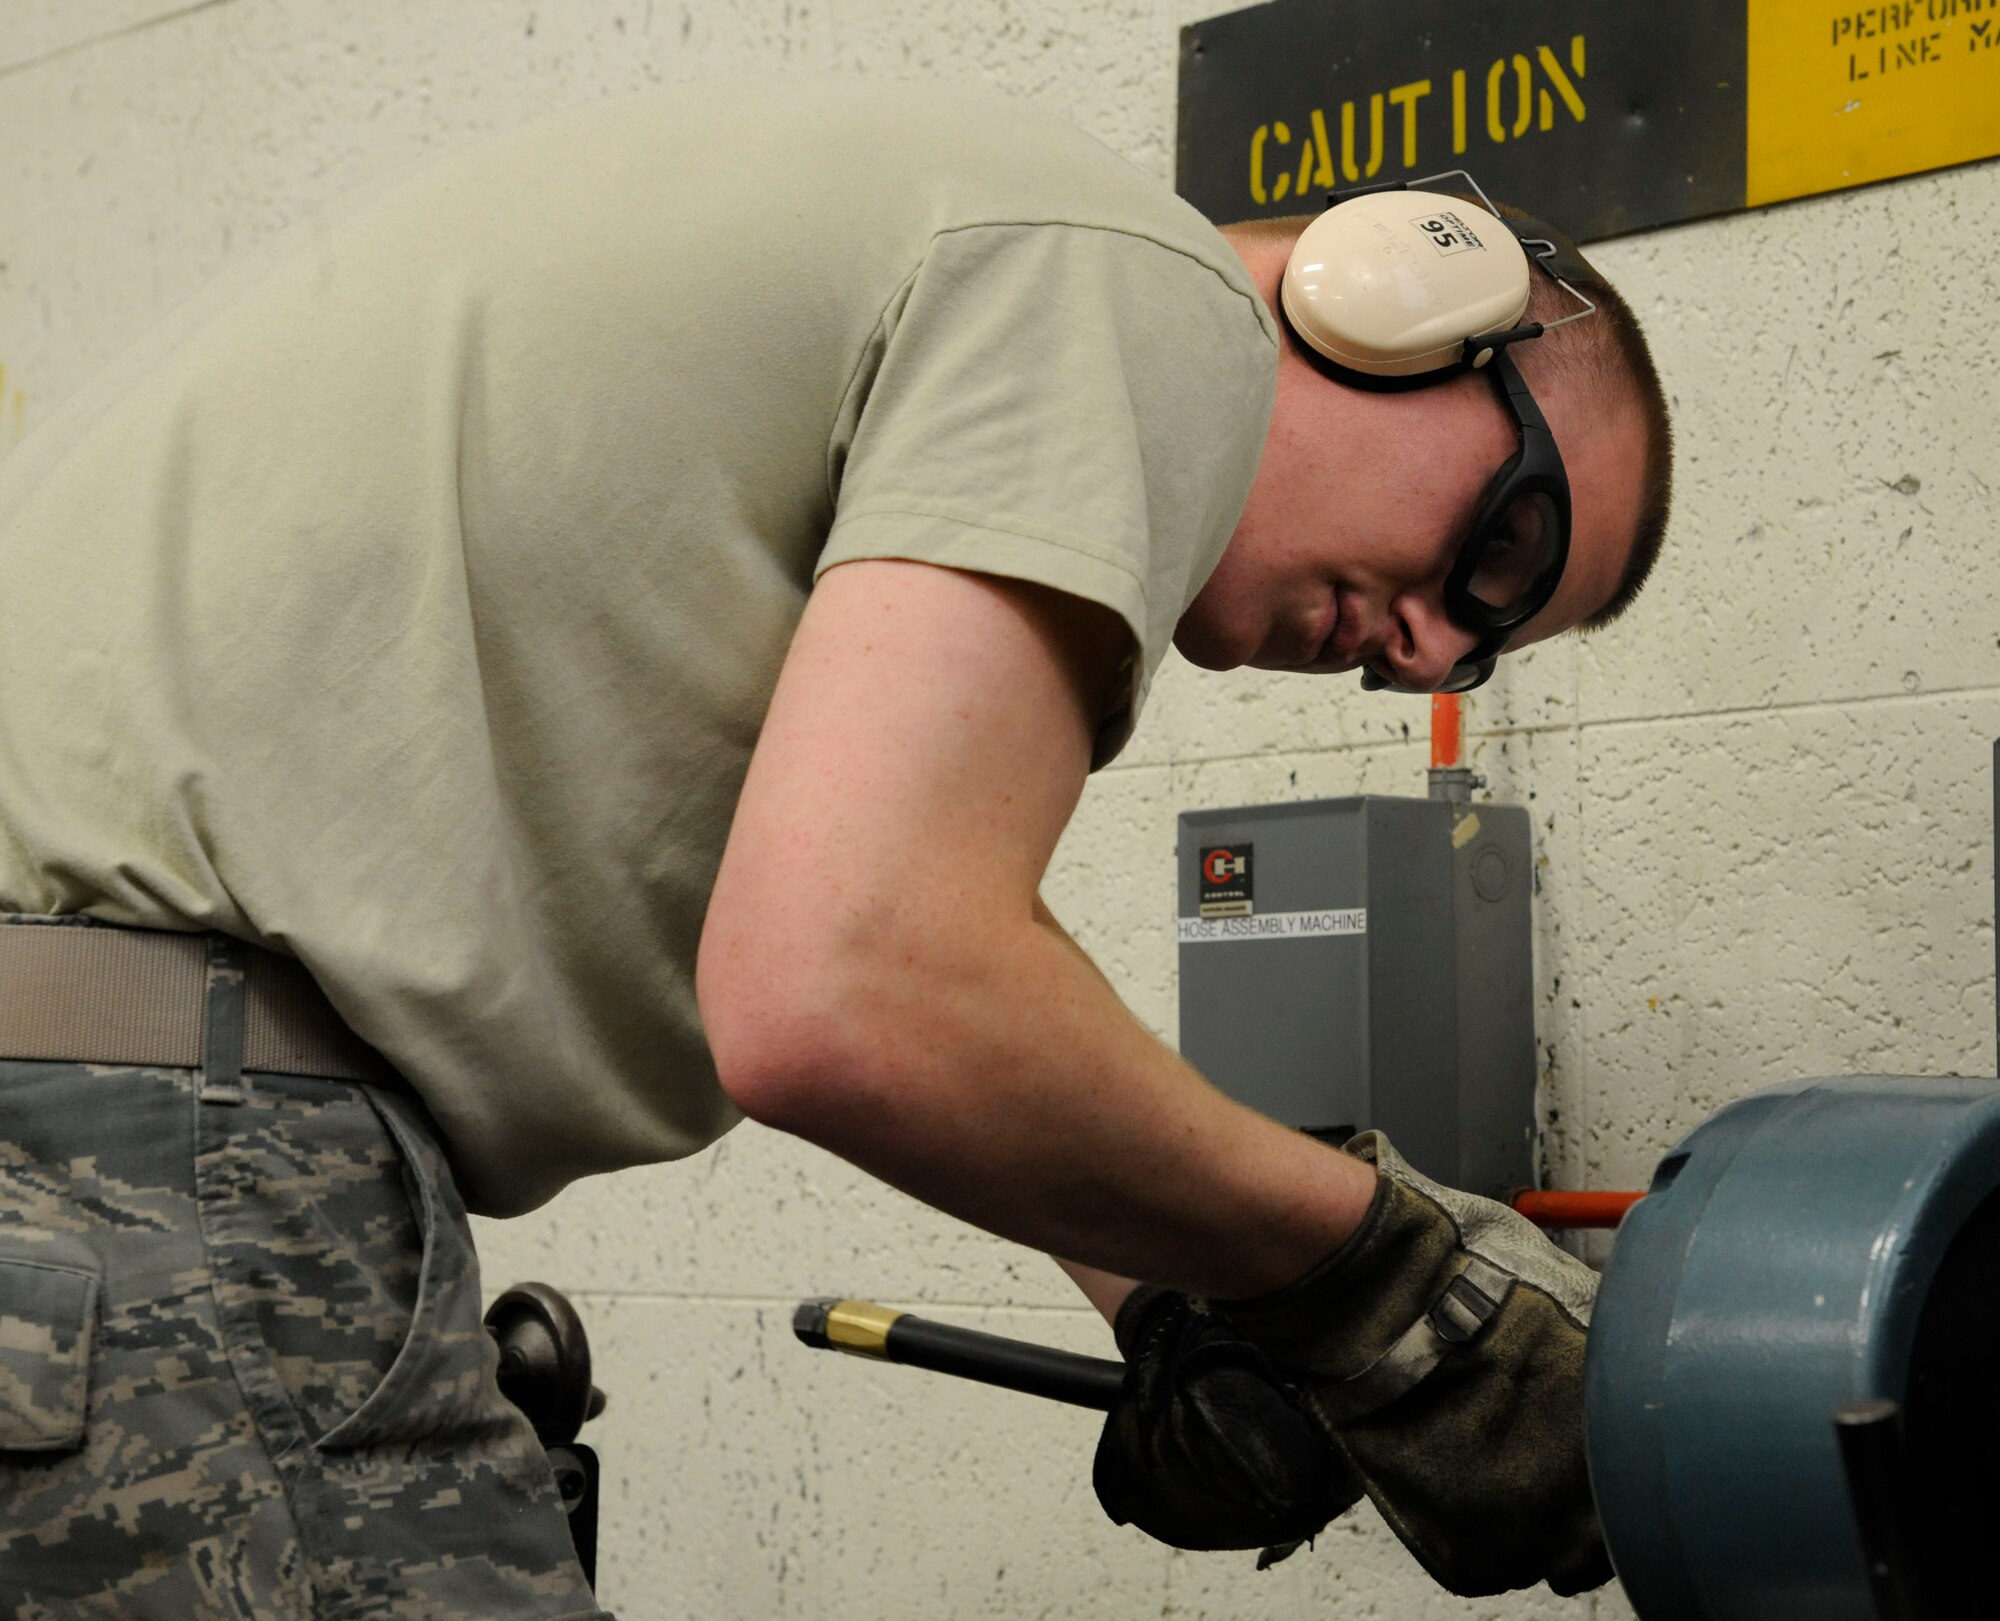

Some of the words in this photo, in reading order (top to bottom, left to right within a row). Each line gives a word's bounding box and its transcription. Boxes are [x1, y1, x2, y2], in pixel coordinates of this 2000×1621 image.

[1850, 33, 1941, 82] LINE
[1250, 34, 1586, 205] CAUTION
[1420, 220, 1459, 248] 95
[1440, 214, 1475, 248] OPTIME
[1178, 920, 1217, 939] HOSE
[1221, 917, 1297, 937] ASSEMBLY
[1301, 912, 1365, 932] MACHINE
